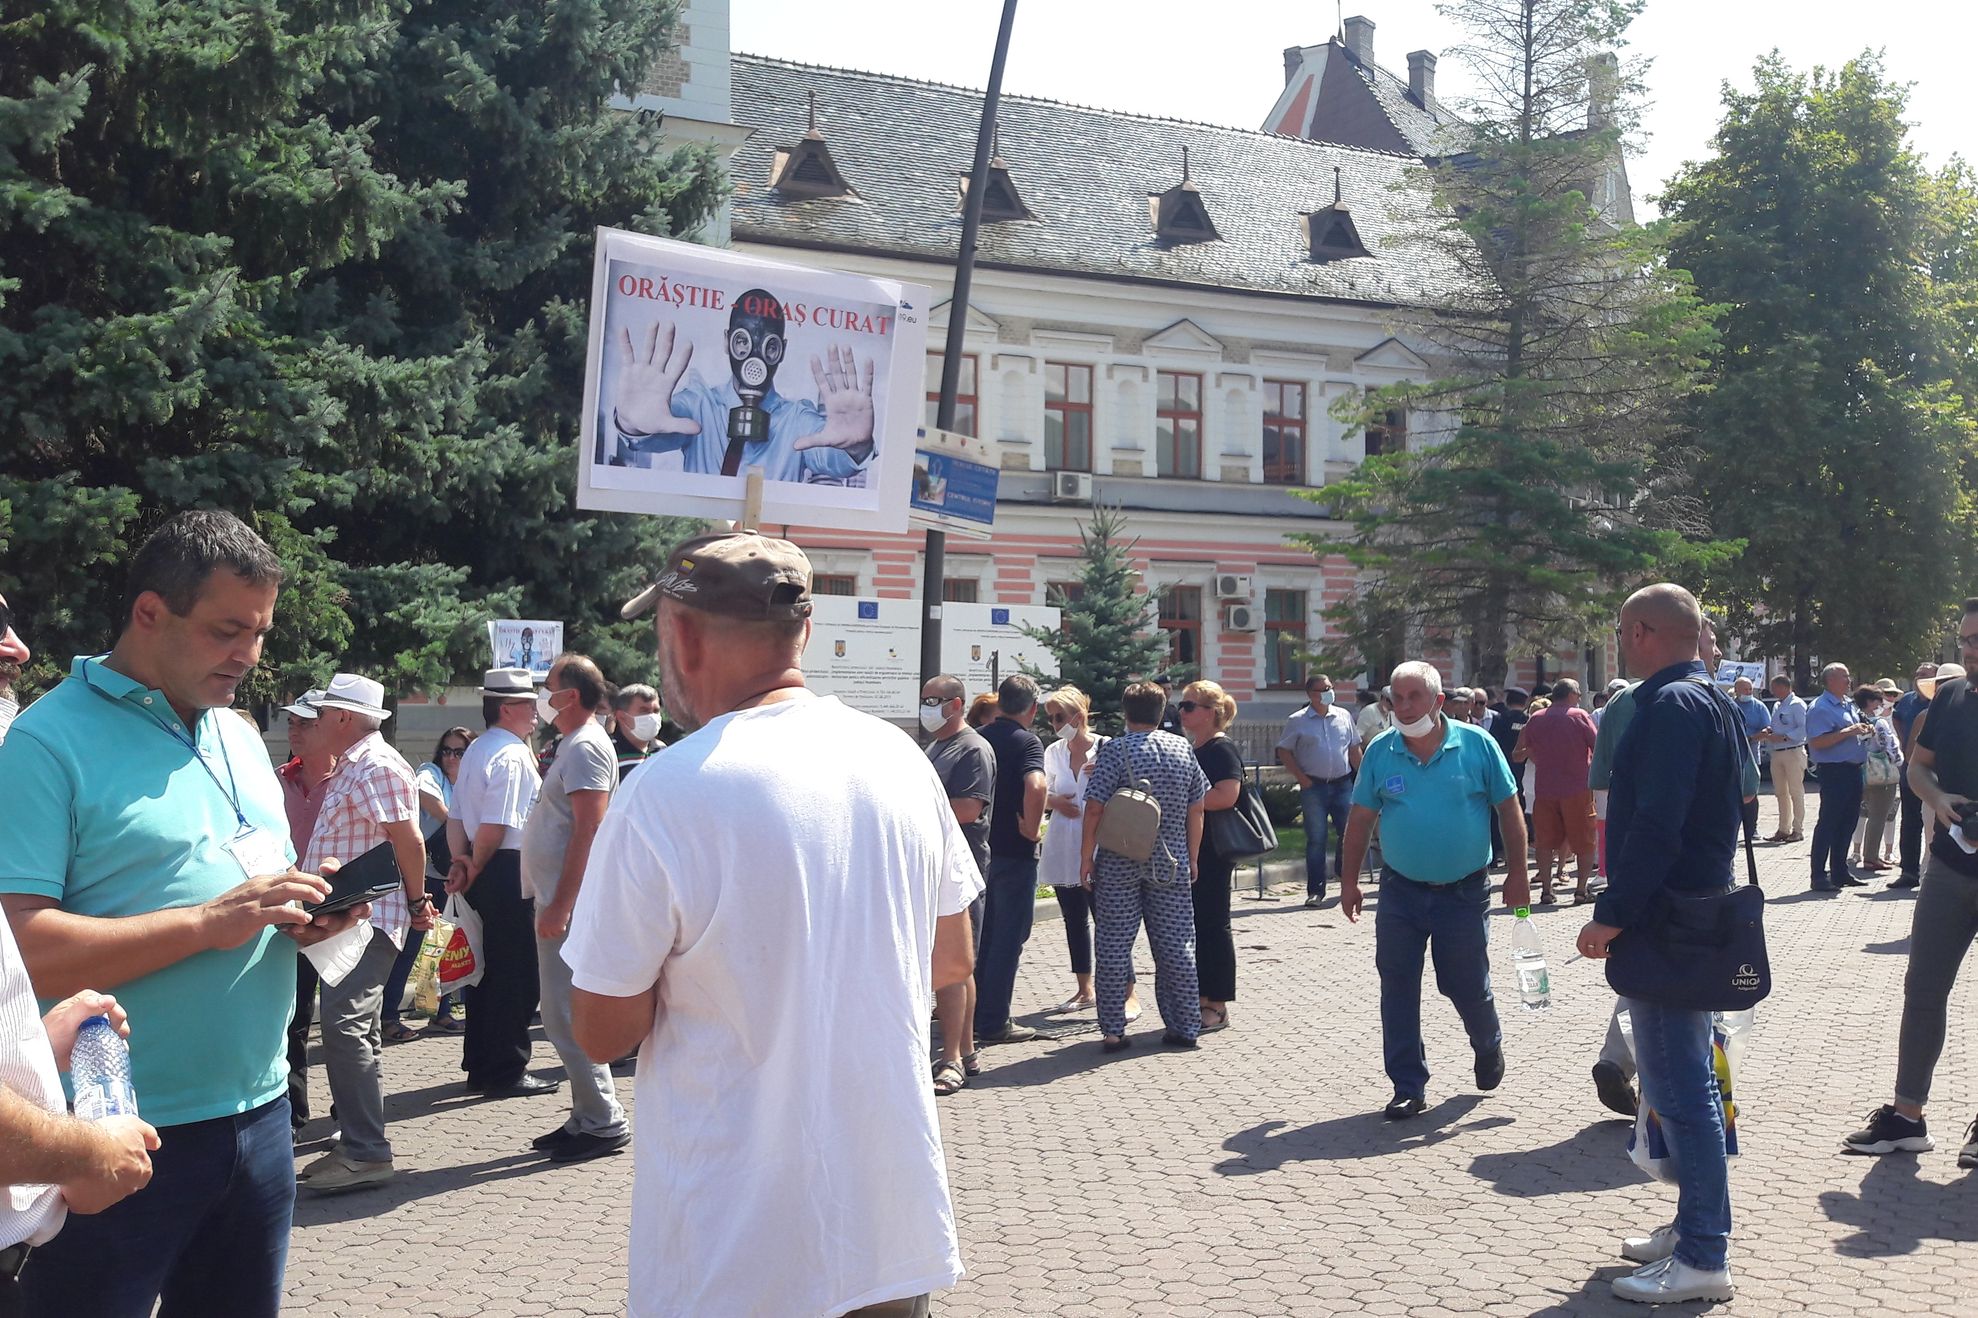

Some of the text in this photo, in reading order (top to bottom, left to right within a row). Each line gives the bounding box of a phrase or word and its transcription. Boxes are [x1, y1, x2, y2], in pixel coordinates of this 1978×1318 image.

[619, 275, 725, 310] ORĂȘTIE
[744, 295, 807, 328] ORAȘ
[813, 306, 892, 335] CURAT
